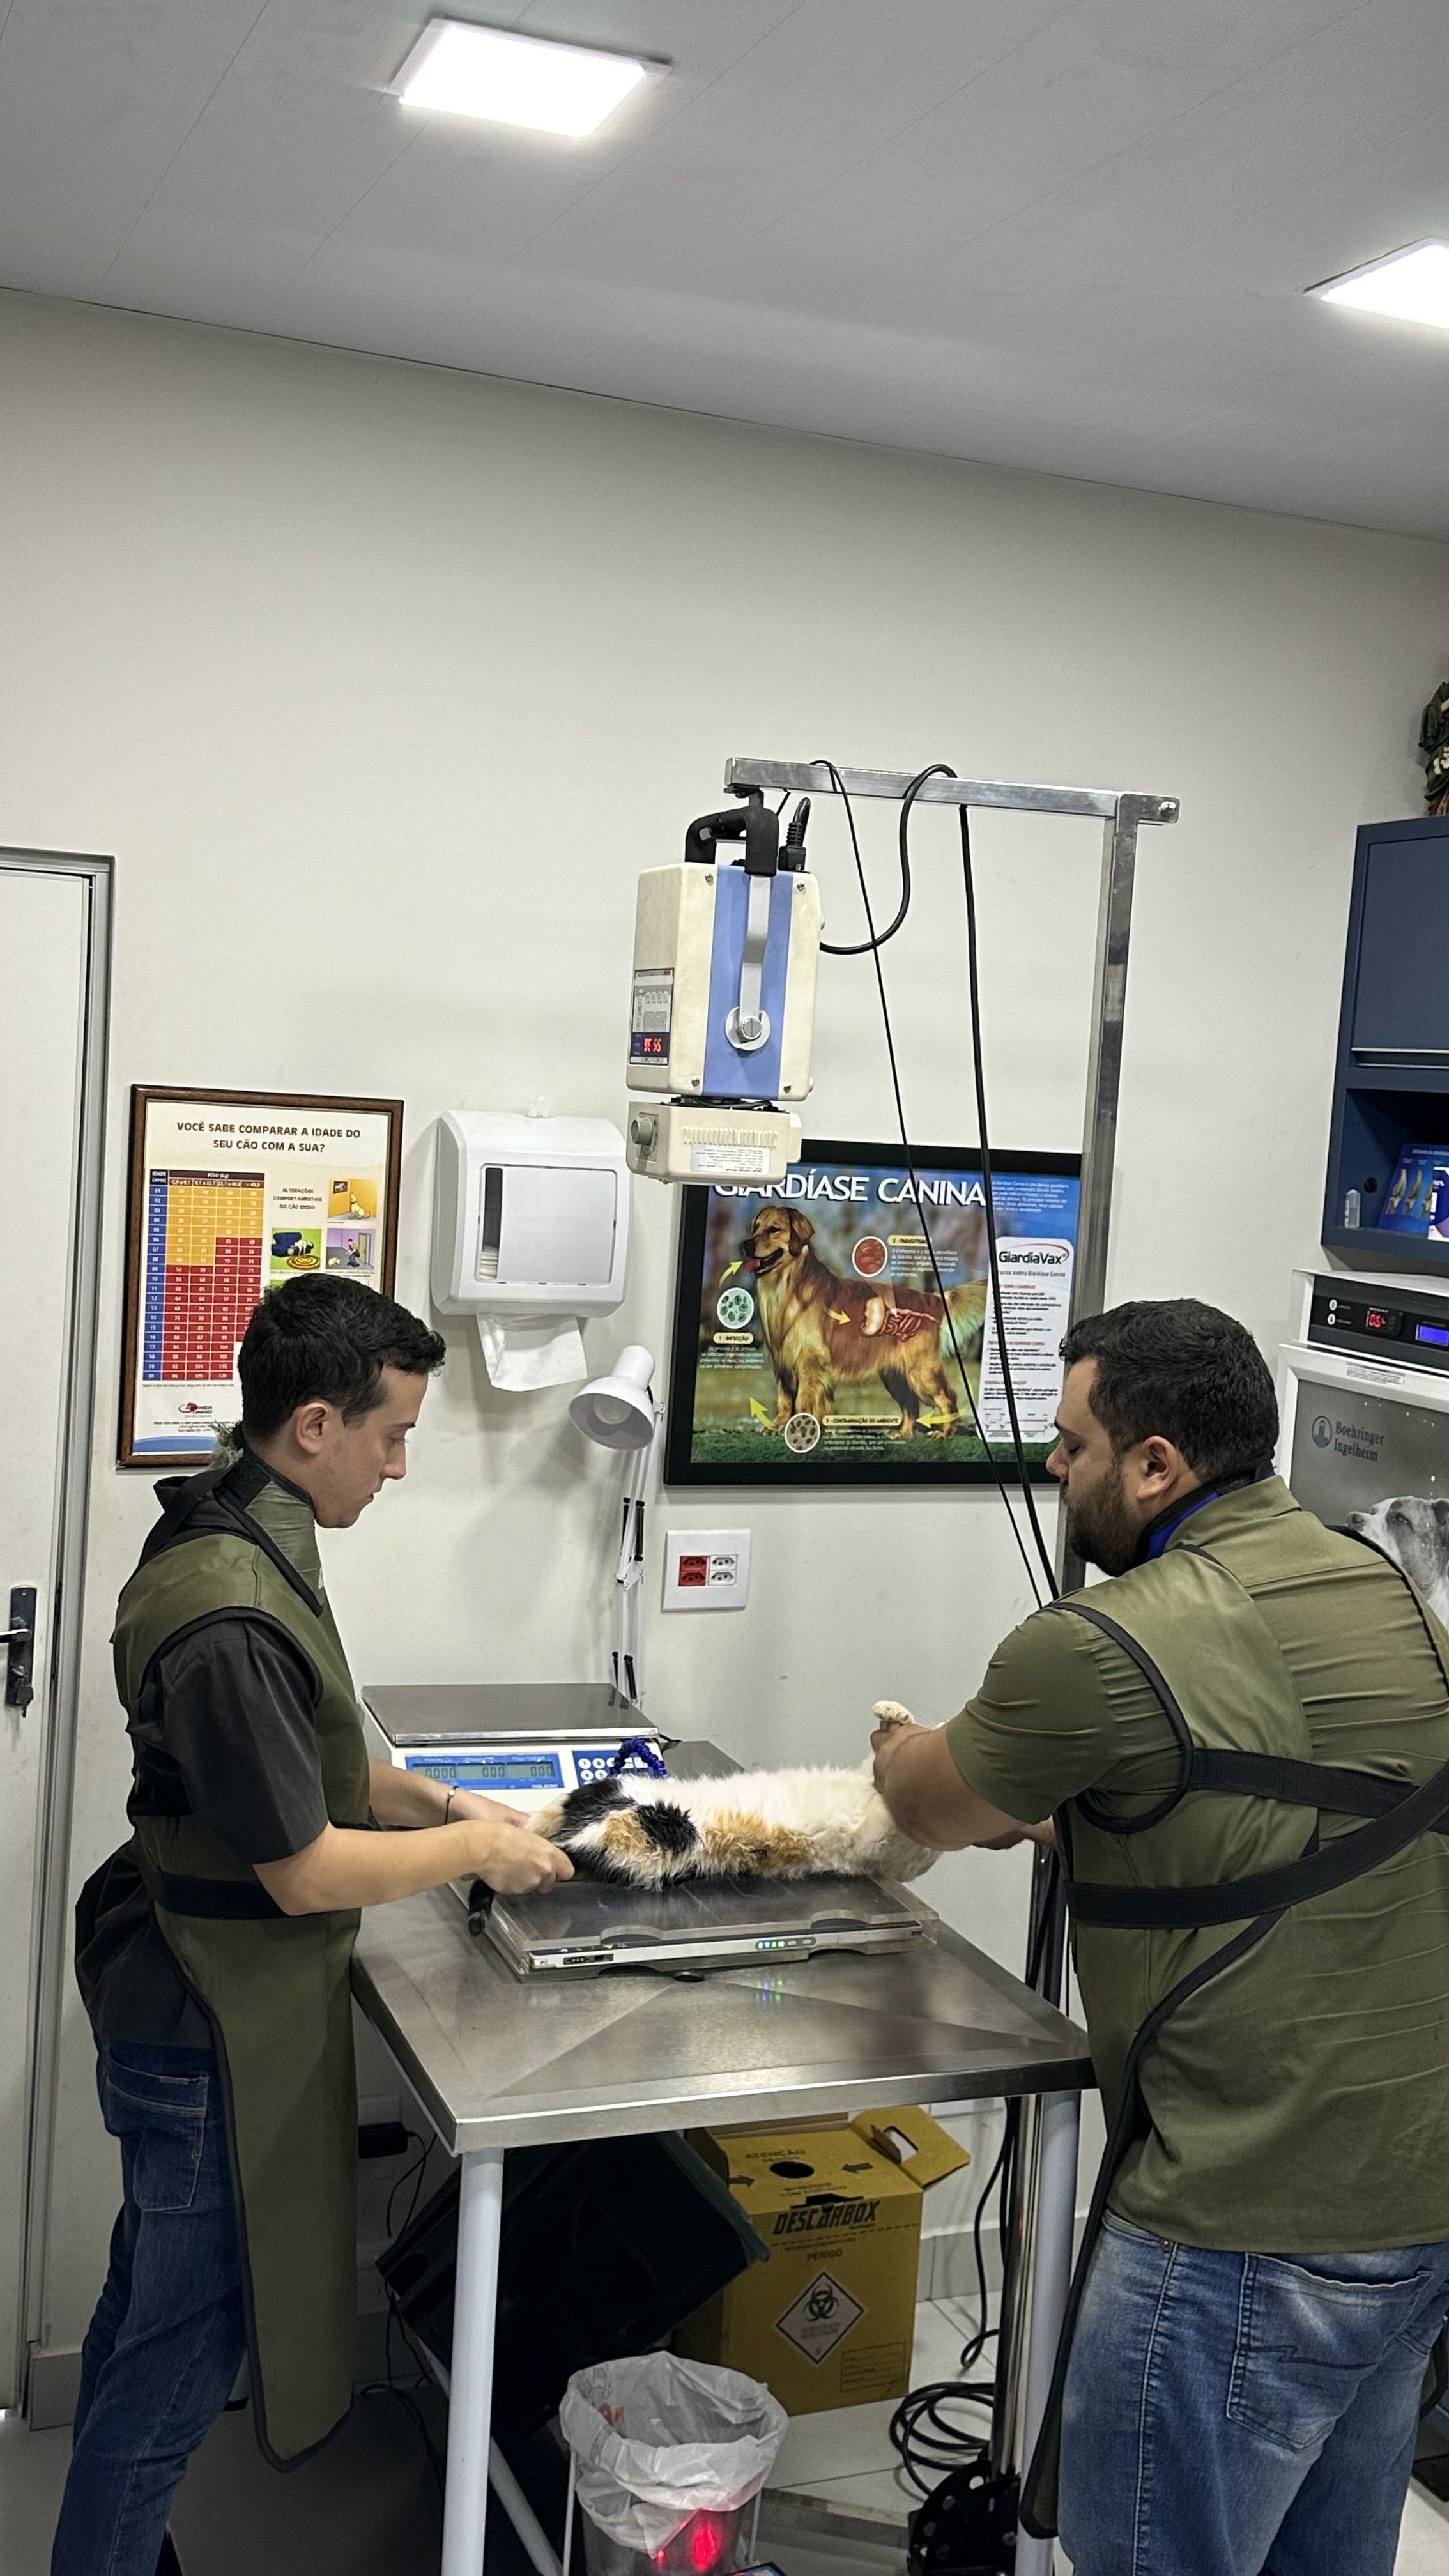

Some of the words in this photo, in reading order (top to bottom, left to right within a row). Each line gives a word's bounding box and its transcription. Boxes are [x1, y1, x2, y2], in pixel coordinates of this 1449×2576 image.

[177, 1121, 205, 1131] VOCÊ
[208, 1123, 236, 1133] SABE
[238, 1124, 298, 1135] COMPARAR
[301, 1128, 309, 1137] A
[312, 1128, 342, 1137] IDADE
[346, 1130, 360, 1138] DO
[213, 1139, 233, 1149] SEU
[236, 1138, 258, 1149] CÃO
[261, 1141, 284, 1151] COM
[288, 1142, 296, 1151] A
[298, 1143, 325, 1153] SUA?
[878, 1177, 986, 1206] CANINA
[1336, 1420, 1384, 1446] Boehringer
[1334, 1438, 1378, 1462] Ingelheim
[772, 2200, 880, 2235] DESCARBOX
